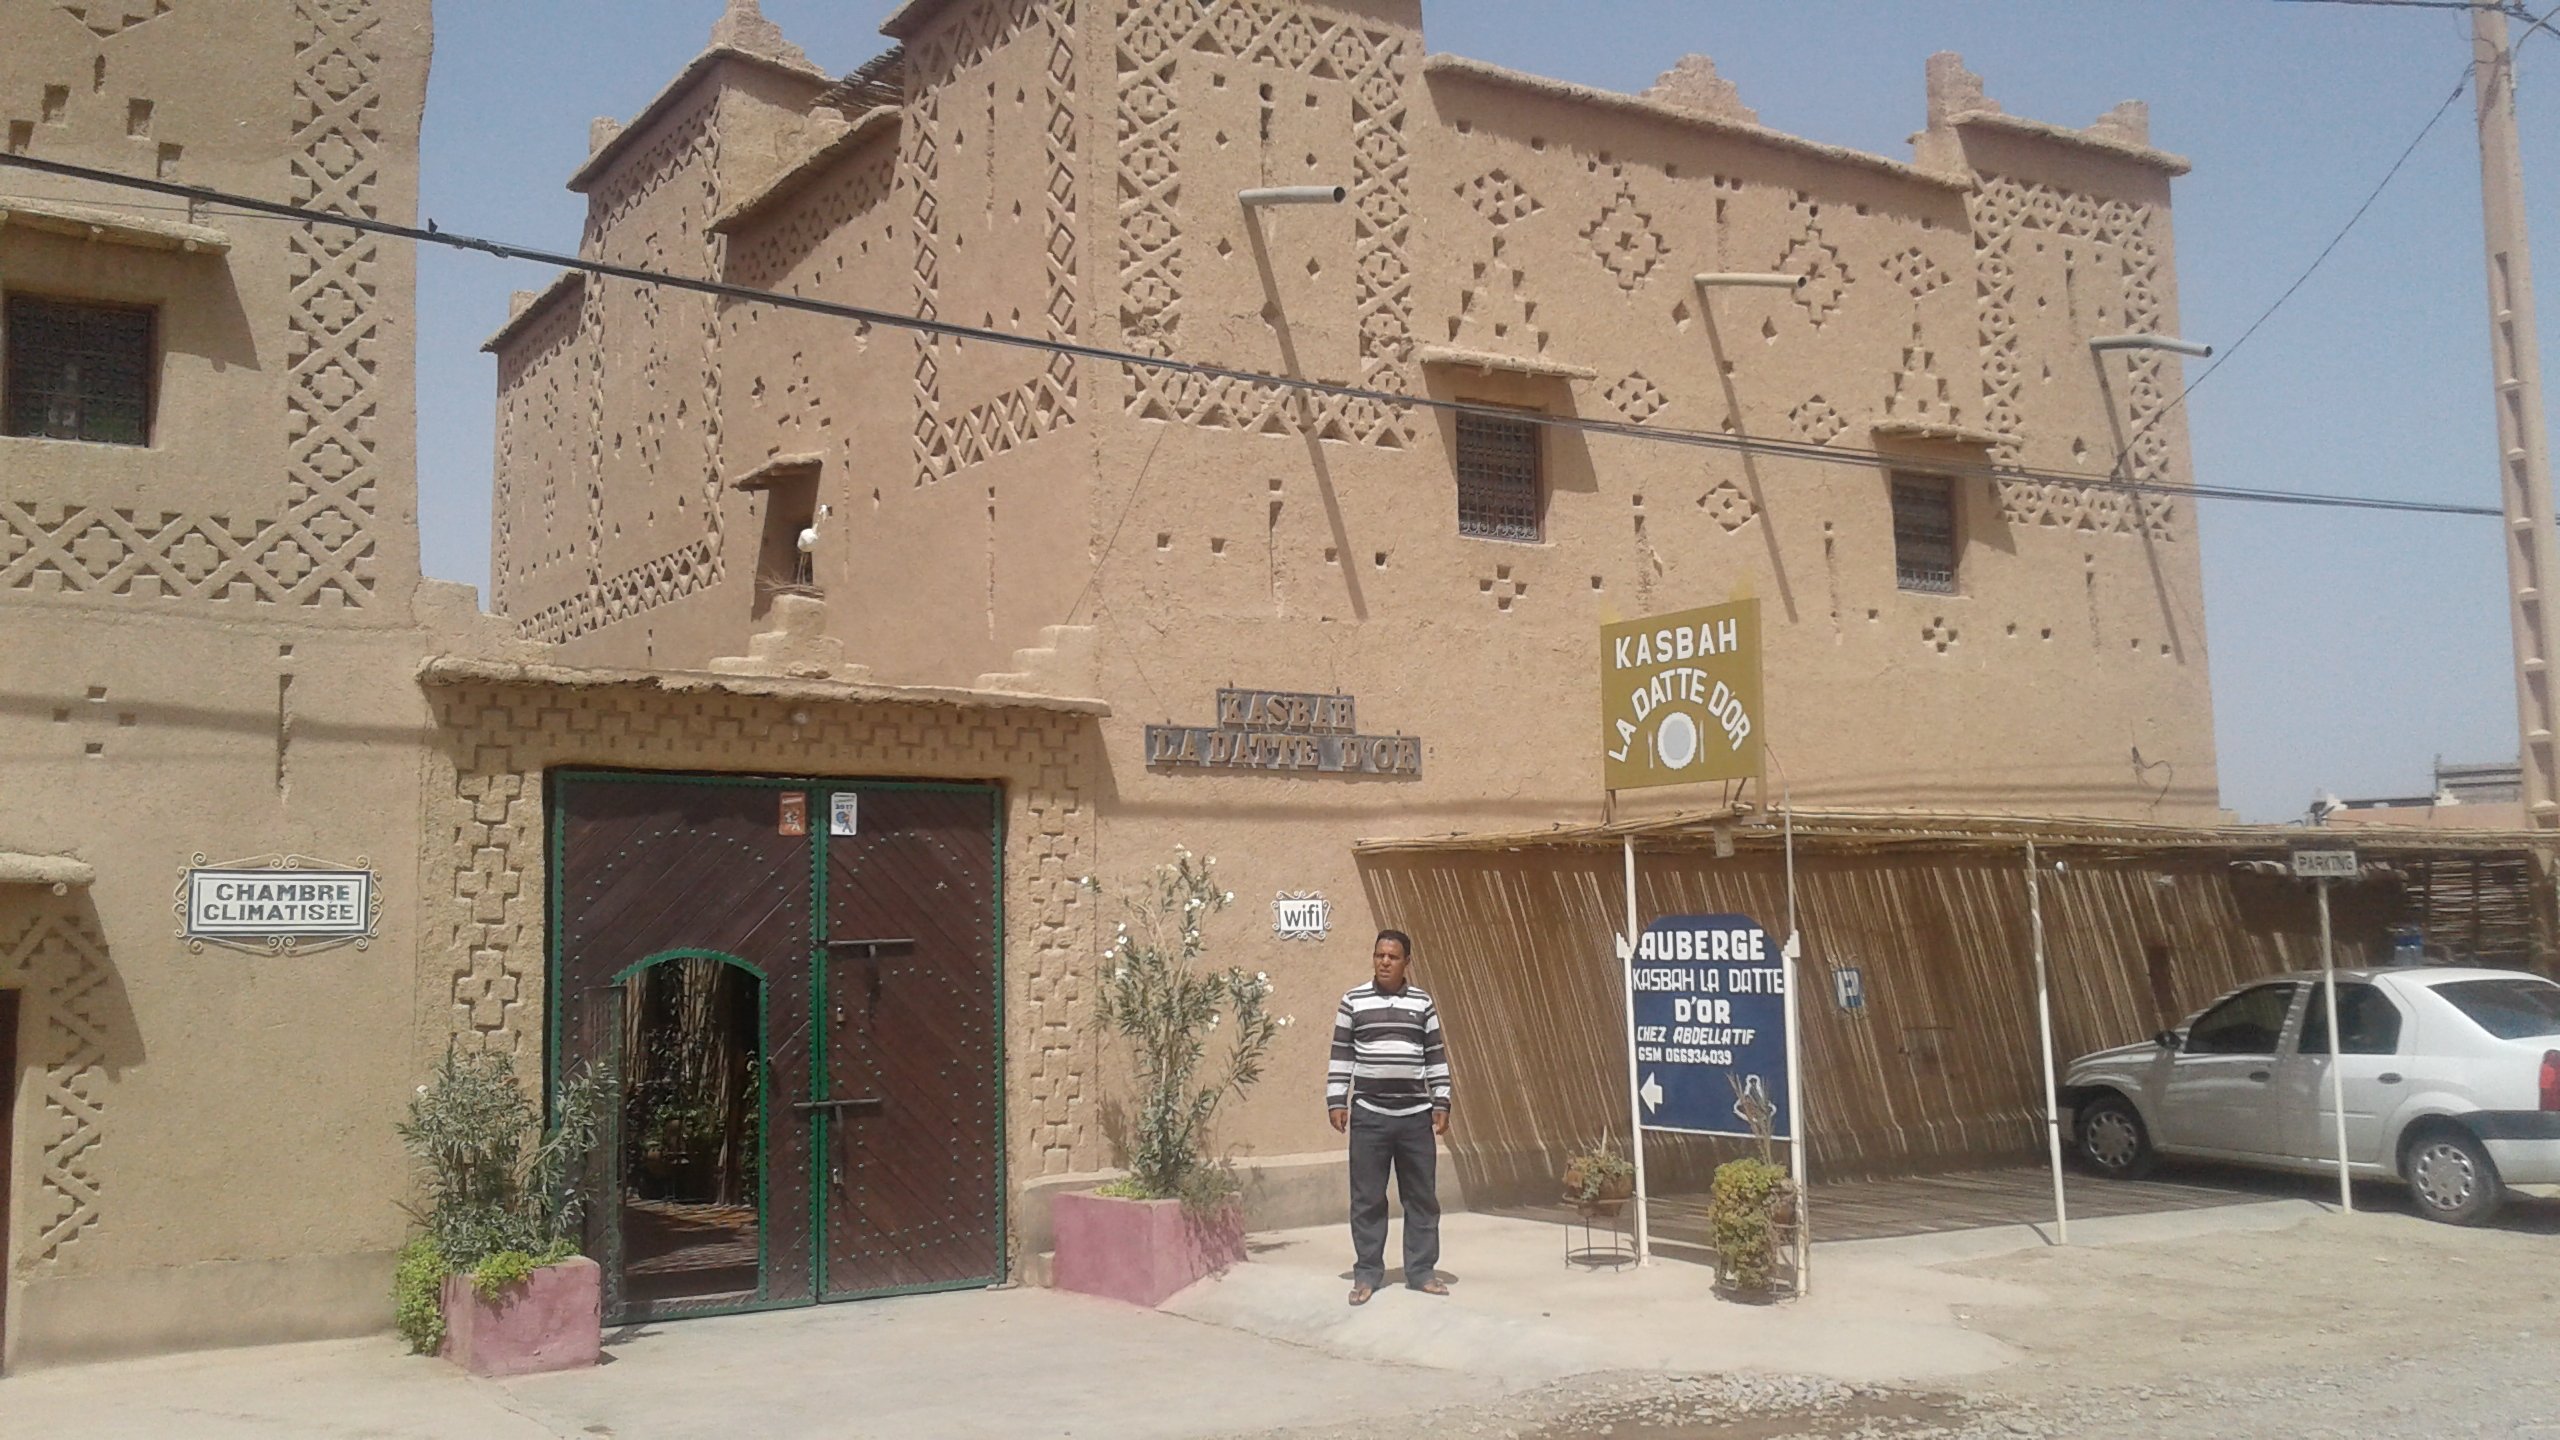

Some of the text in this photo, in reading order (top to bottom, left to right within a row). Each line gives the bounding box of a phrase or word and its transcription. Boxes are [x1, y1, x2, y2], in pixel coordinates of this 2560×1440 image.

[1615, 618, 1737, 669] KASBAH
[1220, 692, 1354, 734] KASBAH
[1608, 718, 1637, 762] LA
[1631, 667, 1707, 722] DATTE
[1152, 728, 1200, 762] LA
[1208, 730, 1319, 768] DATTE
[2298, 855, 2353, 871] PARKING
[216, 883, 350, 902] CHAMBRE
[1284, 904, 1320, 927] wifi
[1639, 929, 1766, 961] AUBERGE
[1632, 968, 1785, 994] KASBAH LA DATTE
[1674, 996, 1731, 1024] D'OR
[1637, 1026, 1756, 1045] CHEZ ABDELLATIF
[1638, 1047, 1662, 1062] GSM
